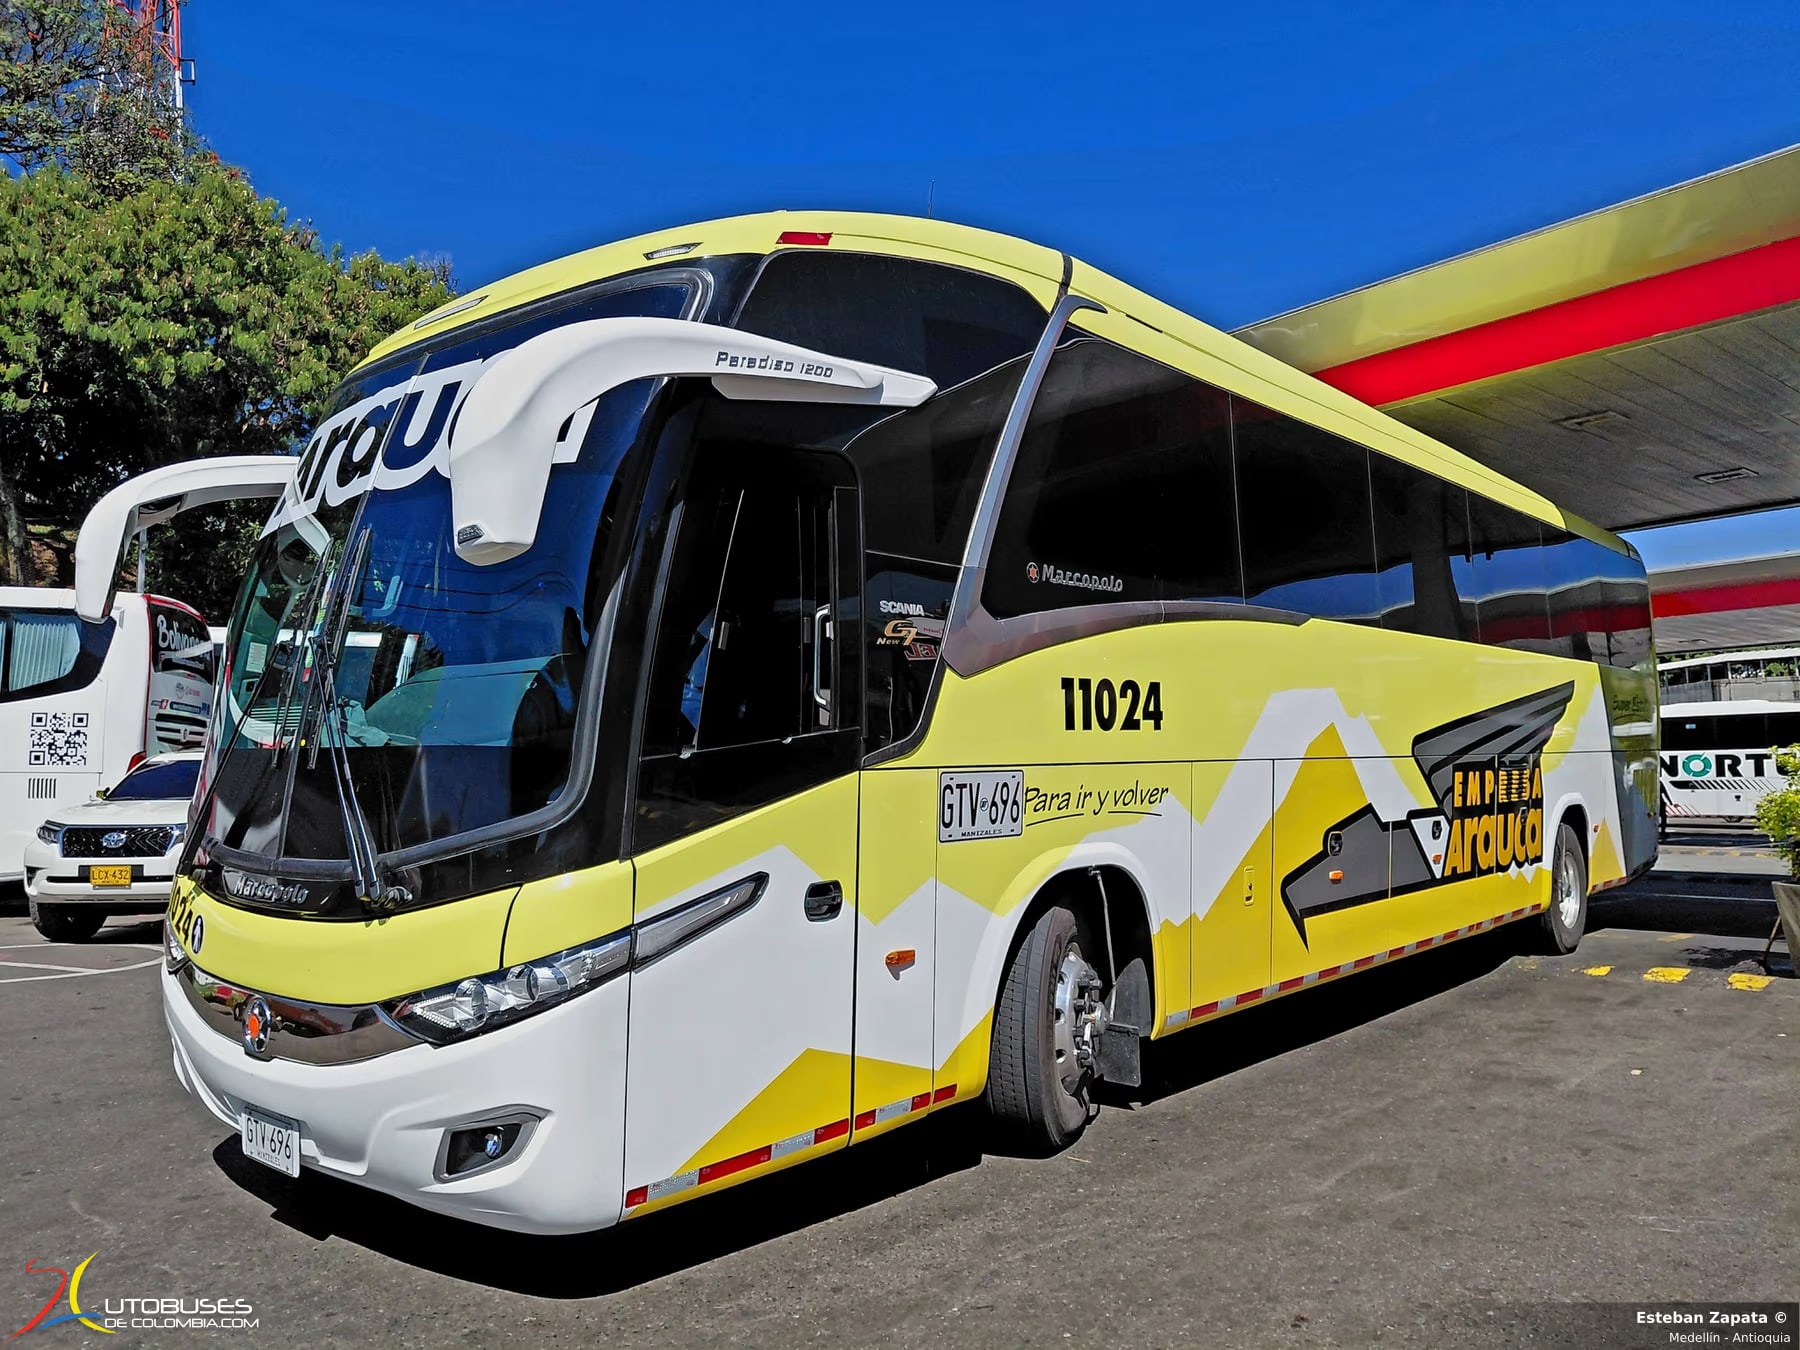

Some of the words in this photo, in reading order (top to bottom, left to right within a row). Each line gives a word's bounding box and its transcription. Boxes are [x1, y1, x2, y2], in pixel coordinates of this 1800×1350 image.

[715, 351, 794, 372] Paradiso
[800, 363, 833, 378] 1200
[1041, 563, 1123, 592] Marcopolo
[880, 600, 925, 616] SCANIA
[1061, 677, 1164, 731] 11024
[1024, 785, 1071, 815] Para
[1076, 784, 1094, 810] ir
[1093, 789, 1109, 816] y
[1113, 779, 1168, 807] volver
[961, 829, 1003, 837] MANIZALES
[1444, 809, 1542, 876] Arauca
[234, 875, 310, 904] Marcopolo
